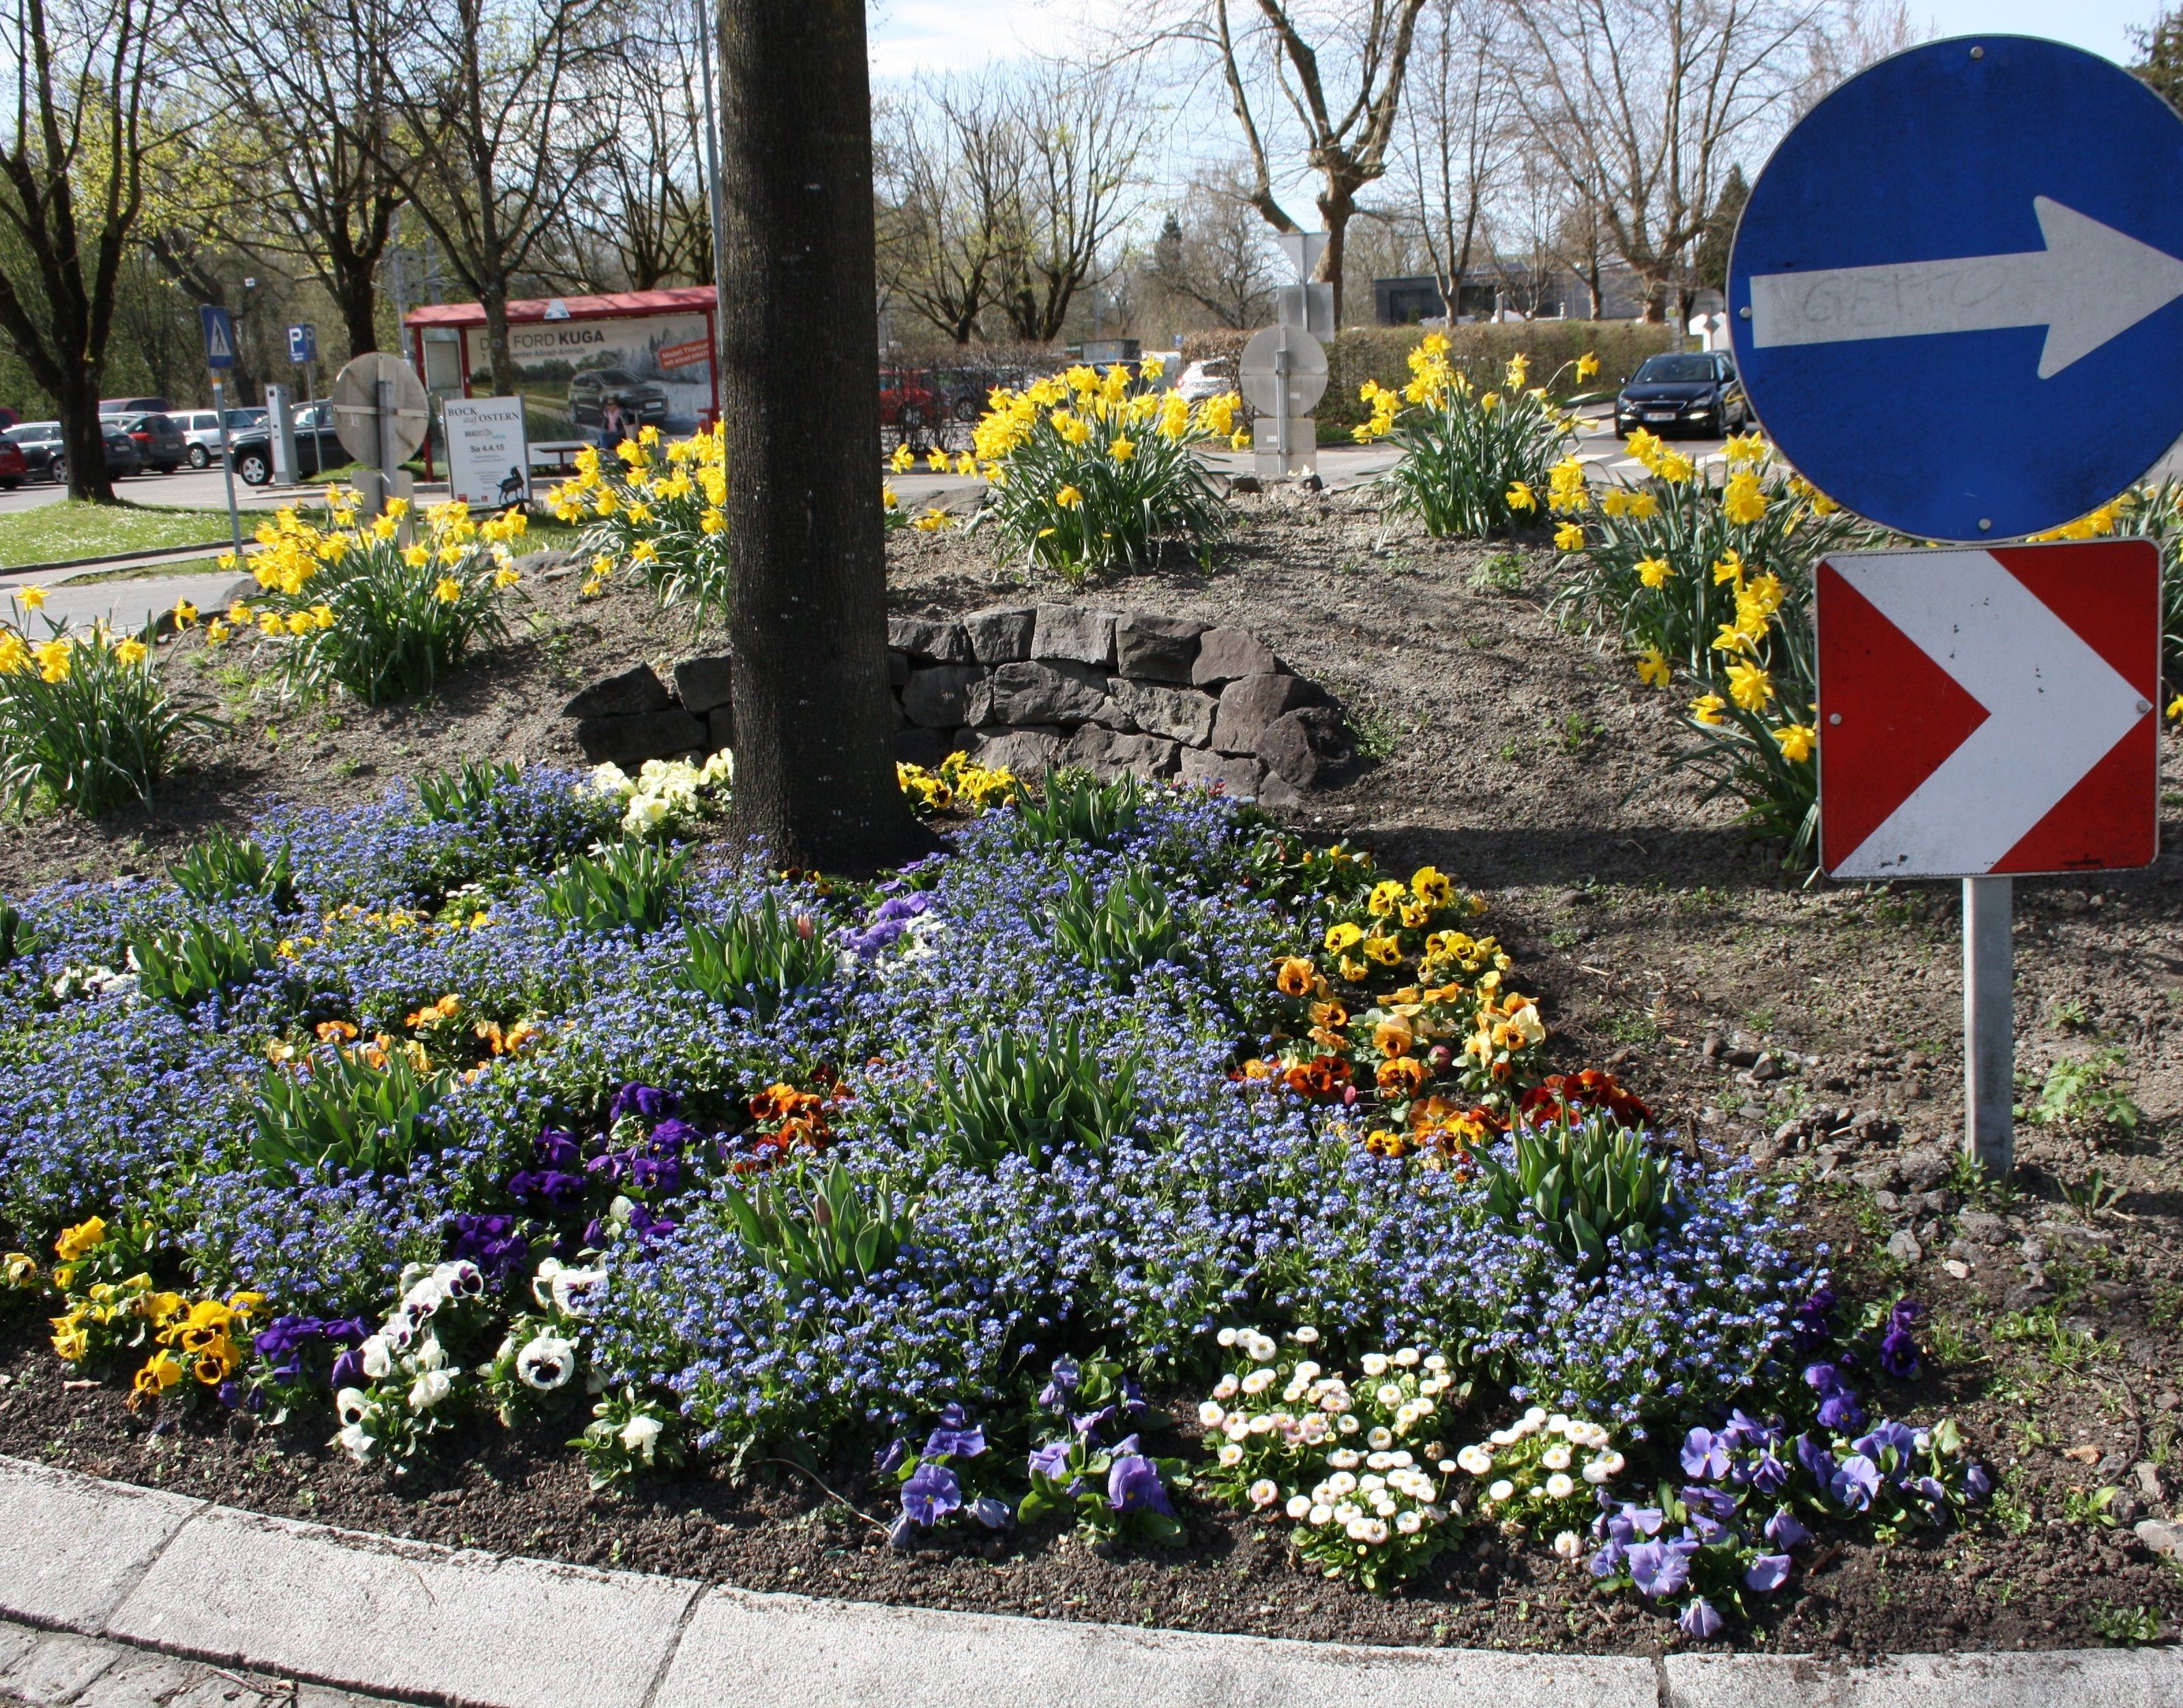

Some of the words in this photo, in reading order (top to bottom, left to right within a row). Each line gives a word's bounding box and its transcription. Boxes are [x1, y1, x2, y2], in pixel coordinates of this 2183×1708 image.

[289, 327, 302, 353] P
[513, 333, 555, 349] FORD
[559, 330, 605, 346] KUGA
[448, 407, 478, 417] BOCK
[463, 415, 477, 426] auf
[479, 412, 520, 422] OSTERN
[482, 443, 505, 452] 4.4.15
